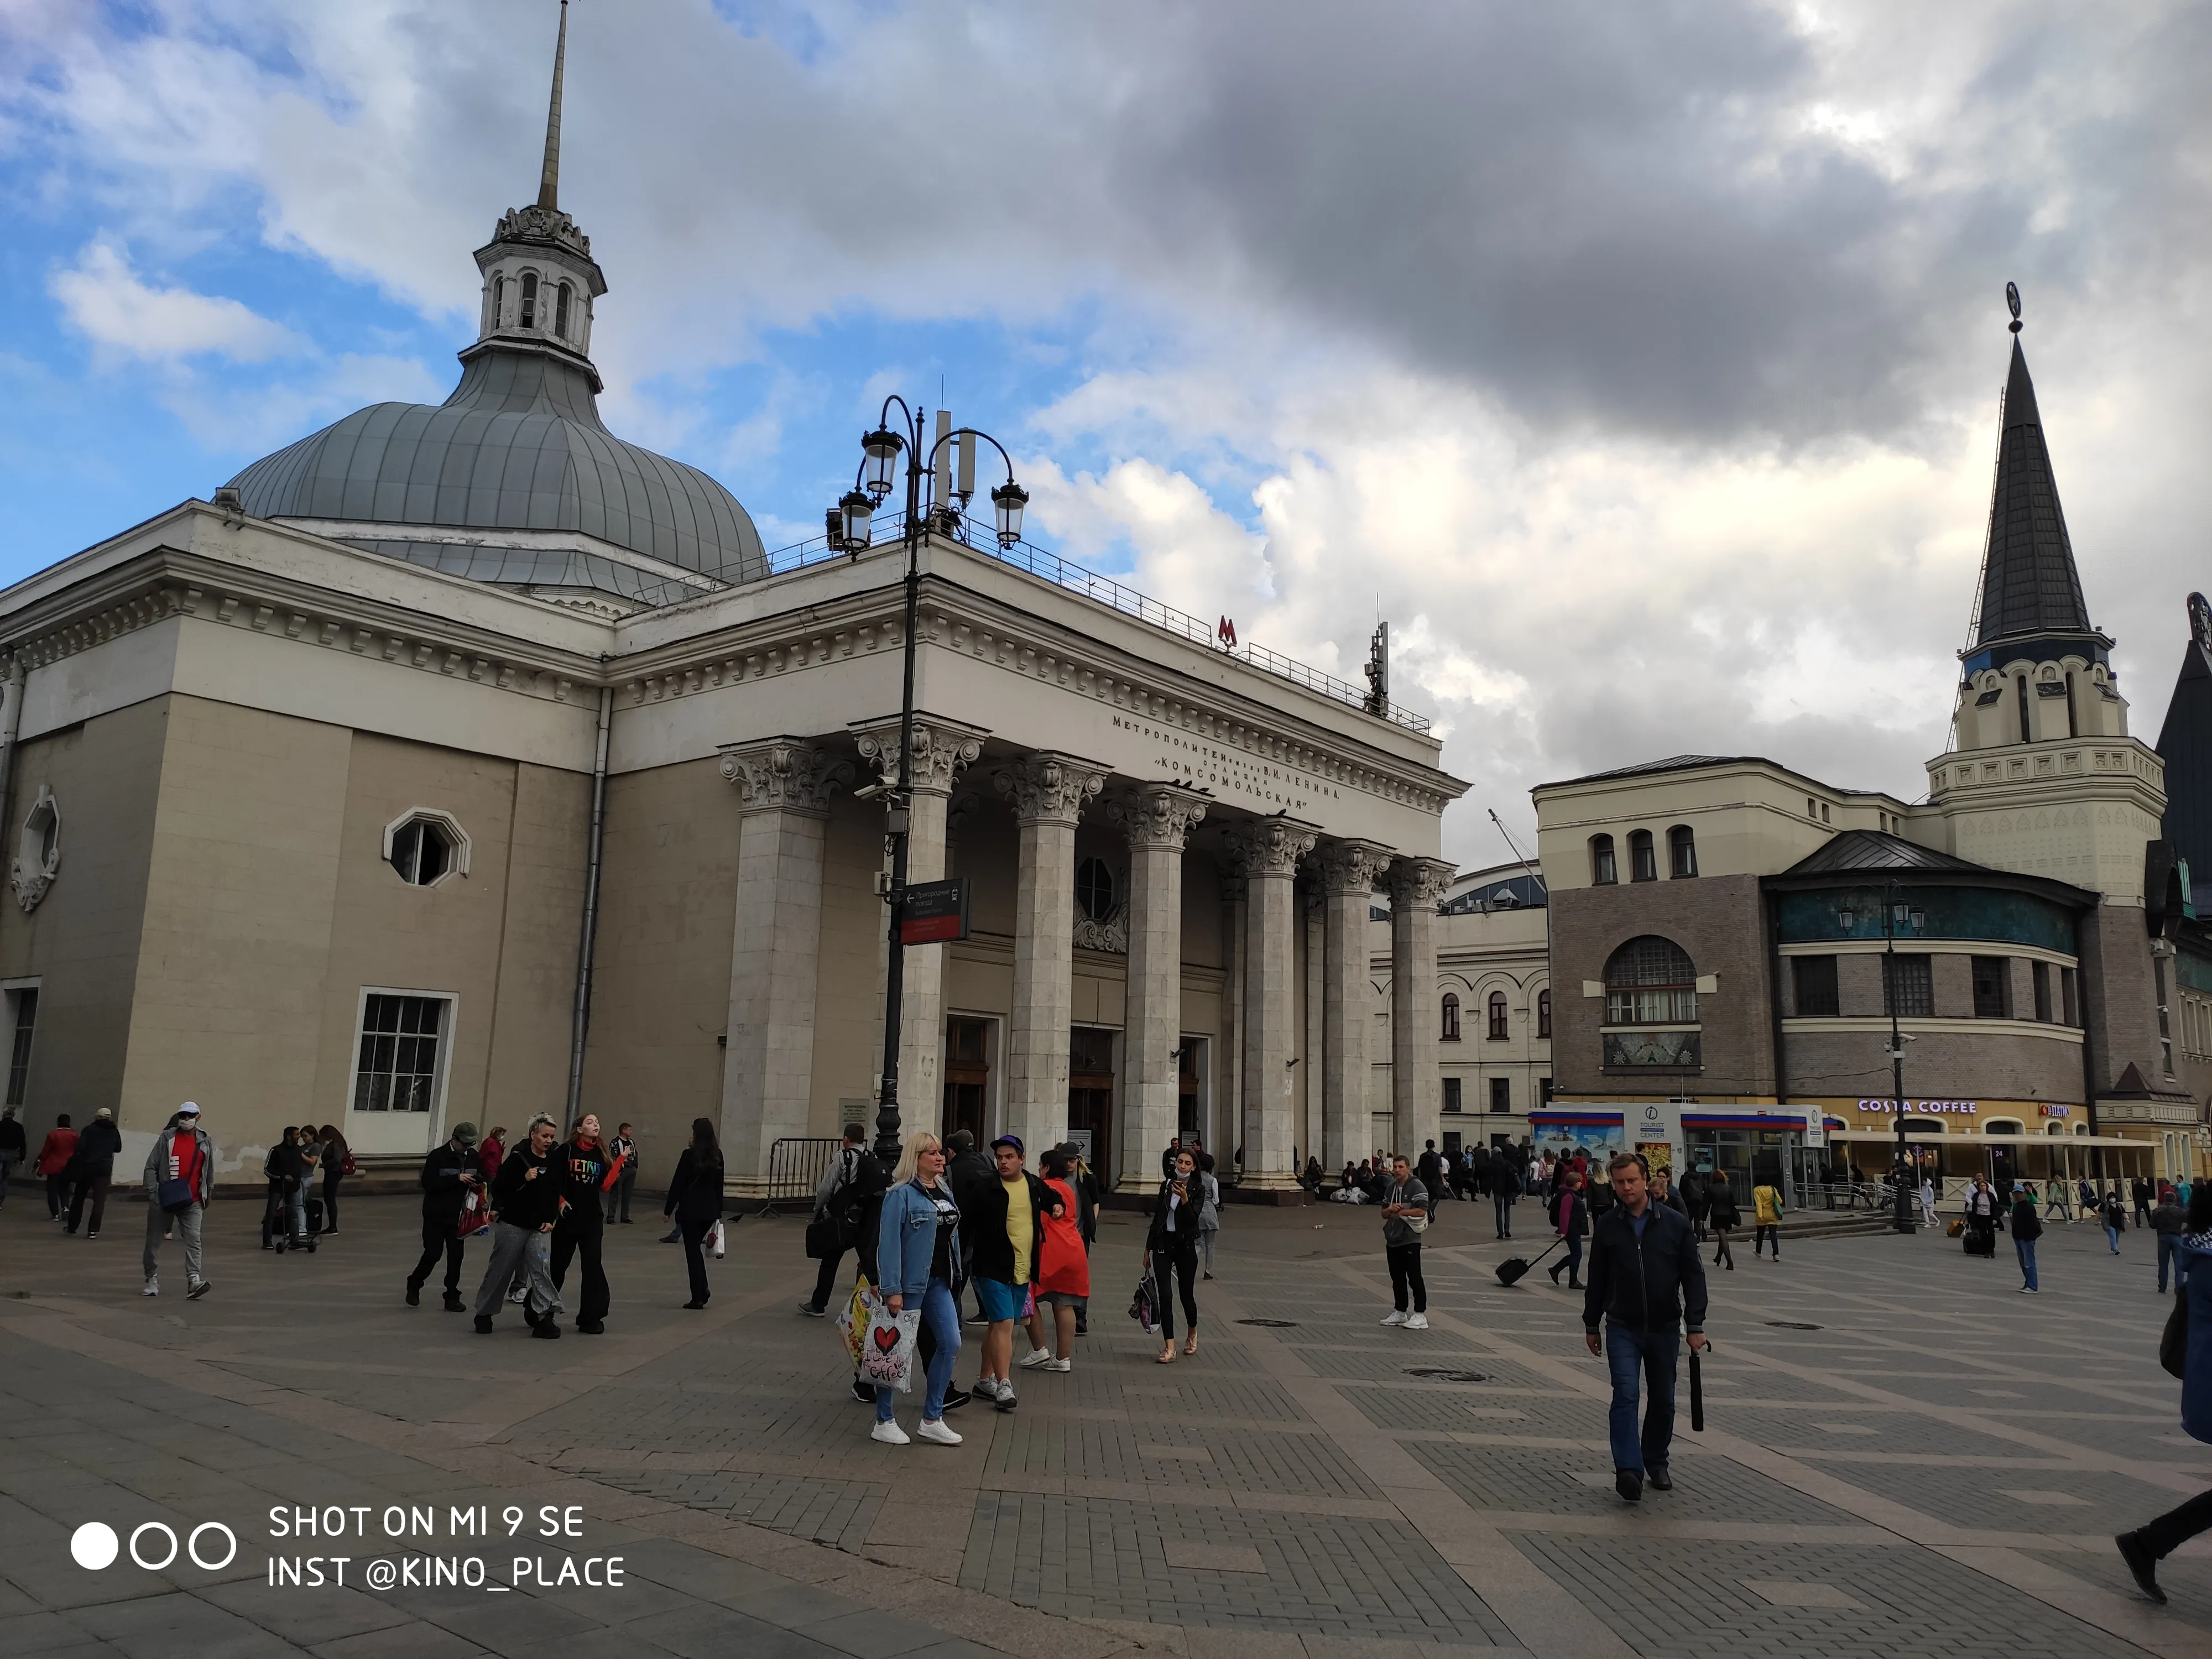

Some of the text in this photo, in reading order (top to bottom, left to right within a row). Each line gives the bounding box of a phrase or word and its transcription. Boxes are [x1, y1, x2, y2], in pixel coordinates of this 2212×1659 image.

[916, 889, 950, 900] Пригородные
[1918, 1100, 1977, 1114] COFFEE
[568, 1159, 601, 1176] TETRIS
[873, 1353, 891, 1363] Love
[870, 1364, 904, 1381] Coffee
